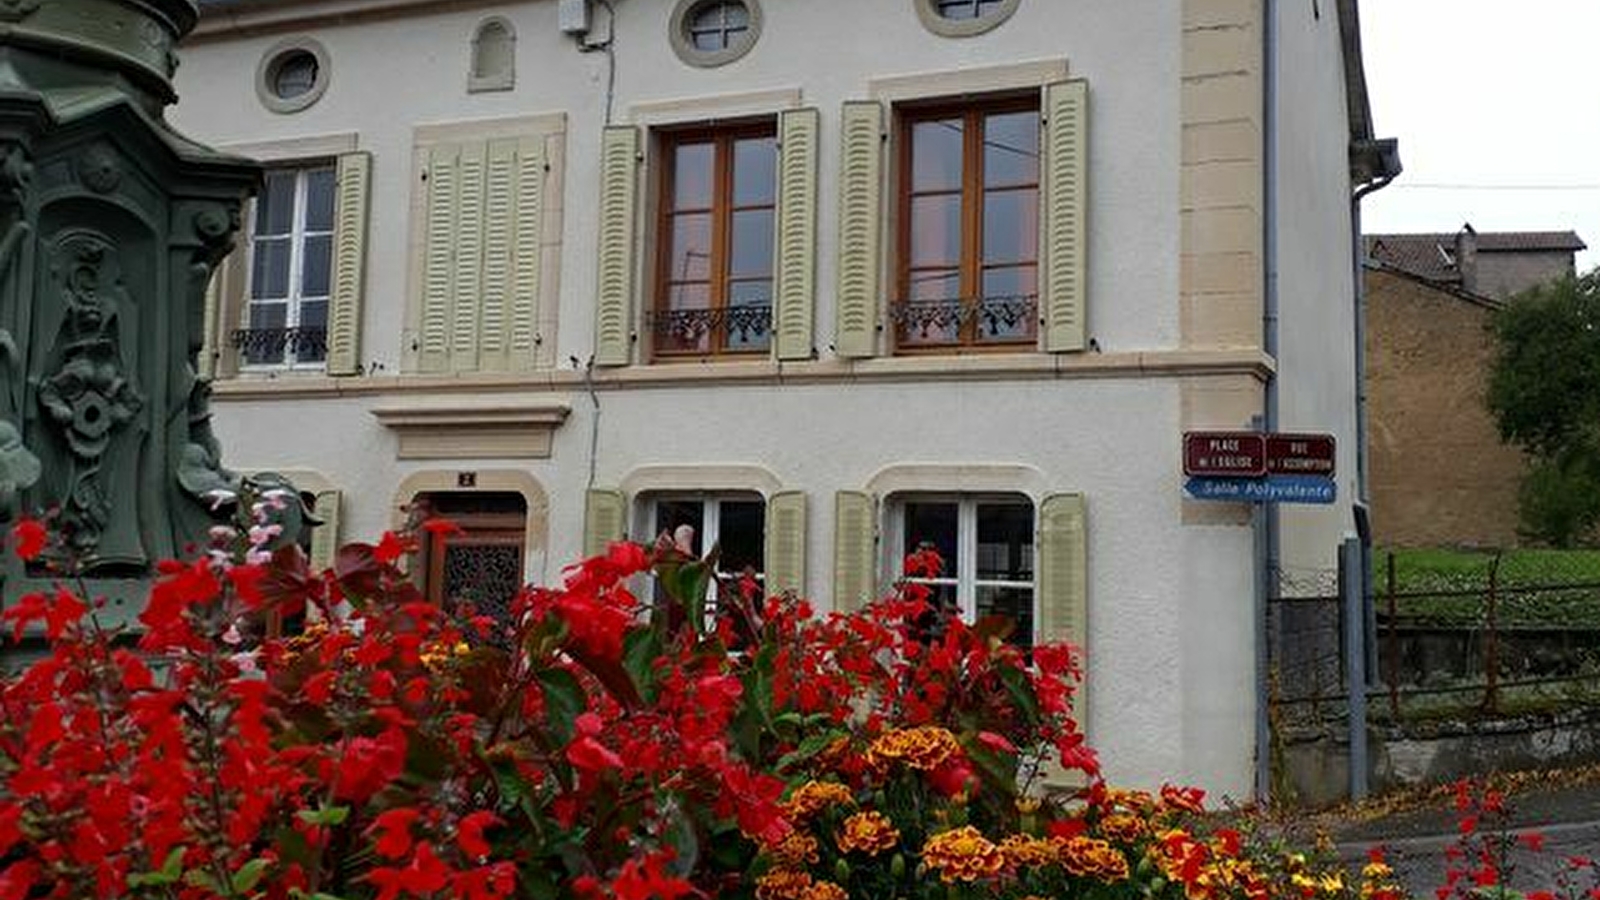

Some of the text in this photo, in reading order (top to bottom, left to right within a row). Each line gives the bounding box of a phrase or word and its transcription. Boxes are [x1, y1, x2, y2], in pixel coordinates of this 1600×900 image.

[1210, 439, 1240, 452] PLACE
[1290, 442, 1308, 454] RUE
[1203, 481, 1333, 498] Salle Polyvalente
